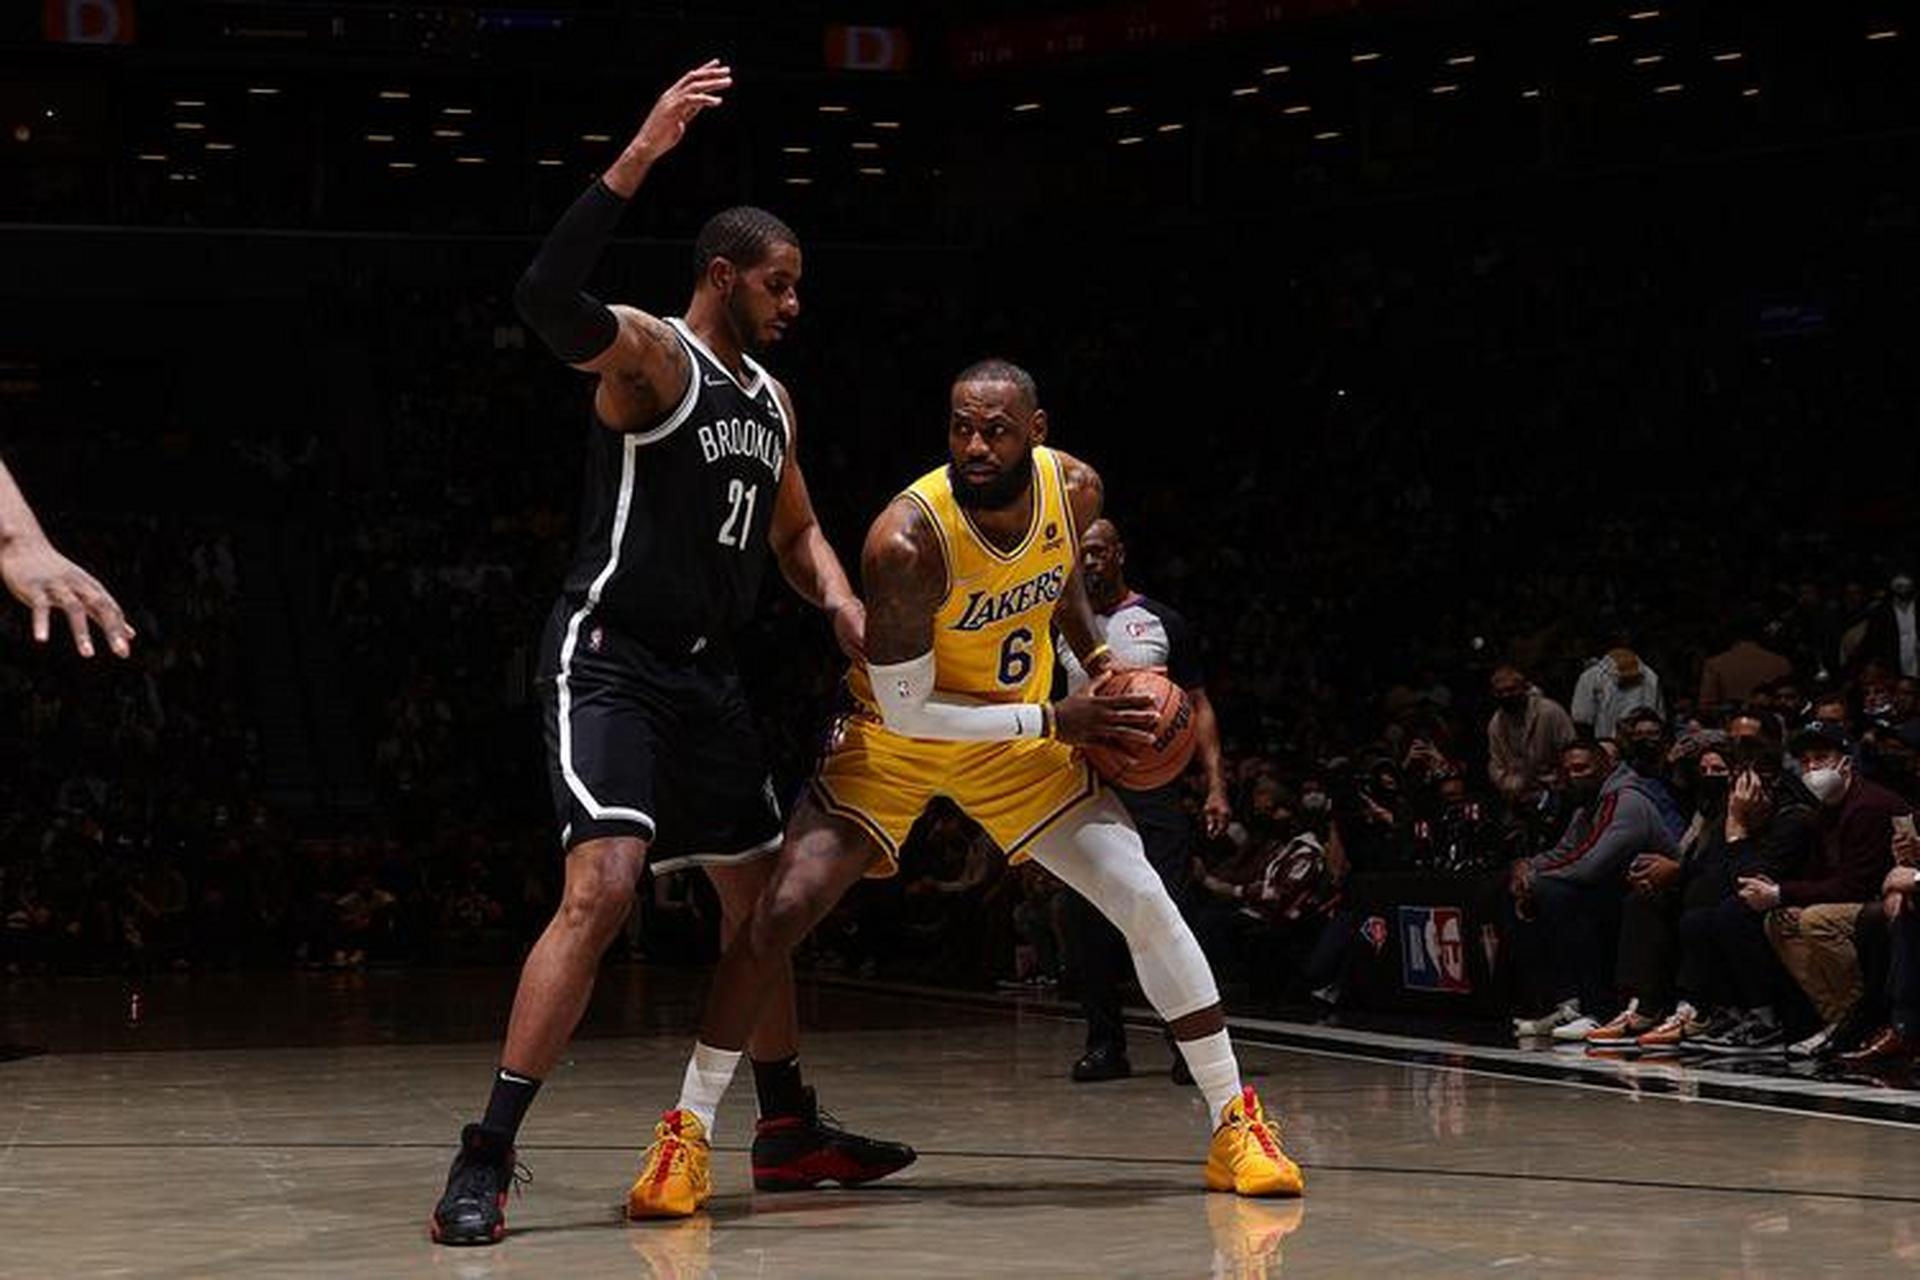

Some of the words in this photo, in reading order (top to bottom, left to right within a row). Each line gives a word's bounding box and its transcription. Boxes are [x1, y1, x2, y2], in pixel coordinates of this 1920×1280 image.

[66, 0, 119, 45] D
[842, 24, 895, 72] D
[698, 417, 784, 482] BROOKL
[718, 478, 757, 551] 21
[949, 564, 1064, 631] LAKERS
[997, 626, 1033, 686] 6
